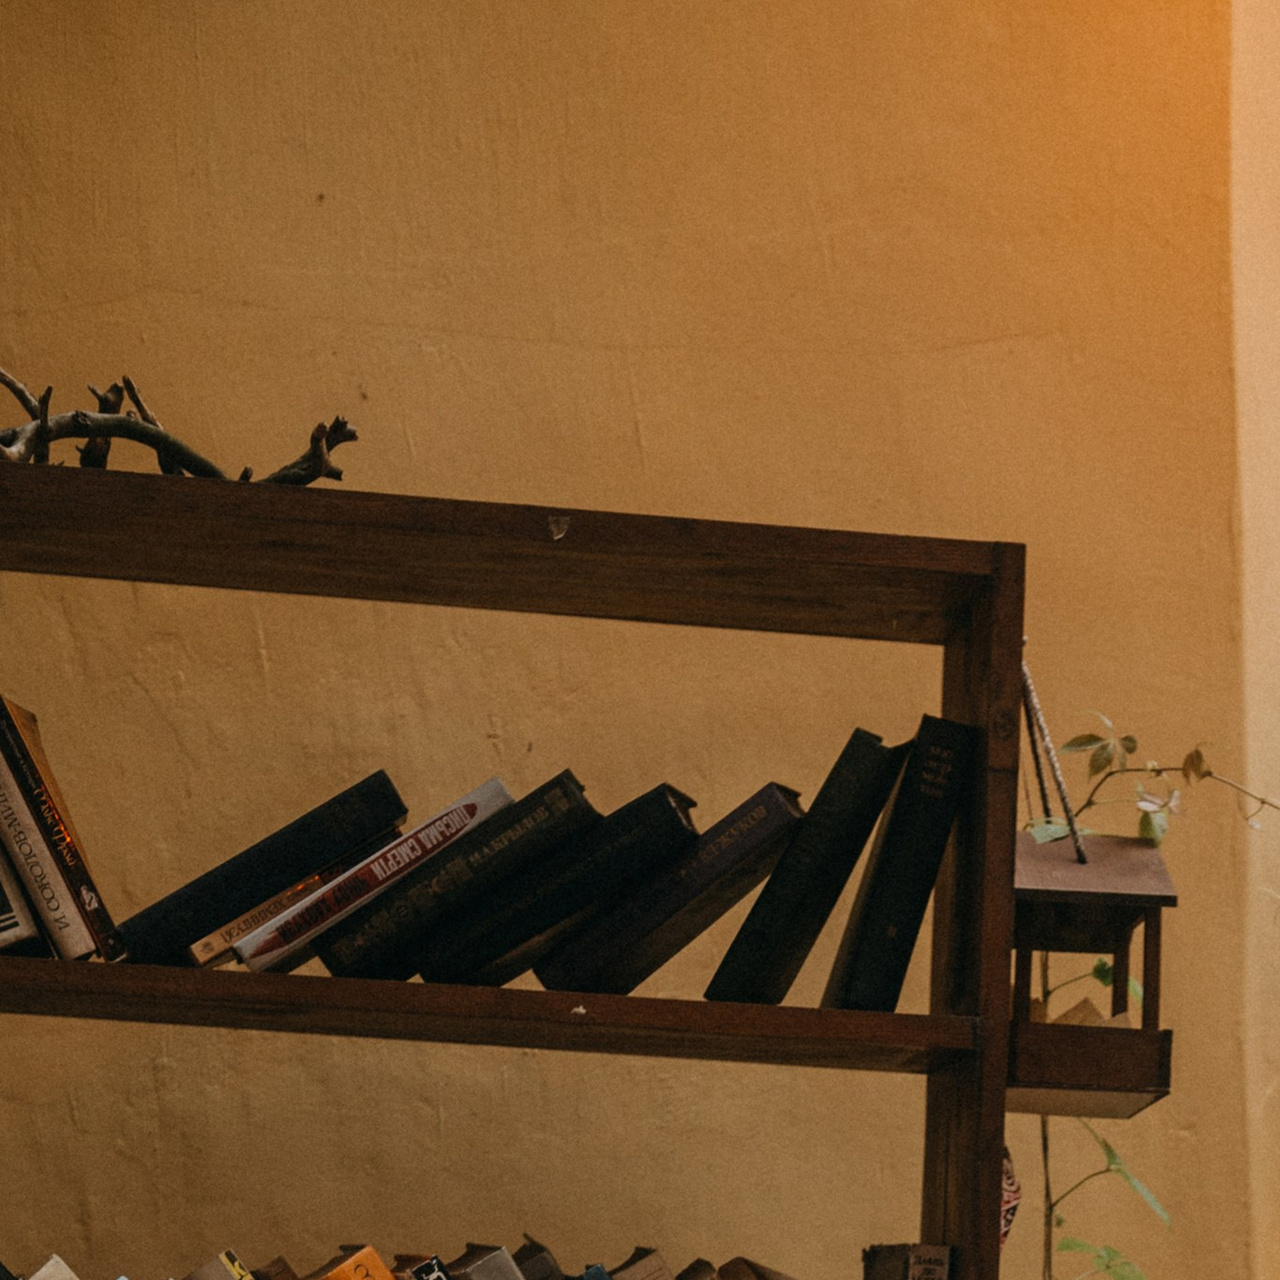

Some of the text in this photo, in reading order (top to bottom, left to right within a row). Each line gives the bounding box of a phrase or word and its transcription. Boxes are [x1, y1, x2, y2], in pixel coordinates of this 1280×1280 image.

[0, 790, 70, 931] И. СОКОЛОВ-МИ
[370, 806, 467, 881] ПИСЬМА СМЕРТИ
